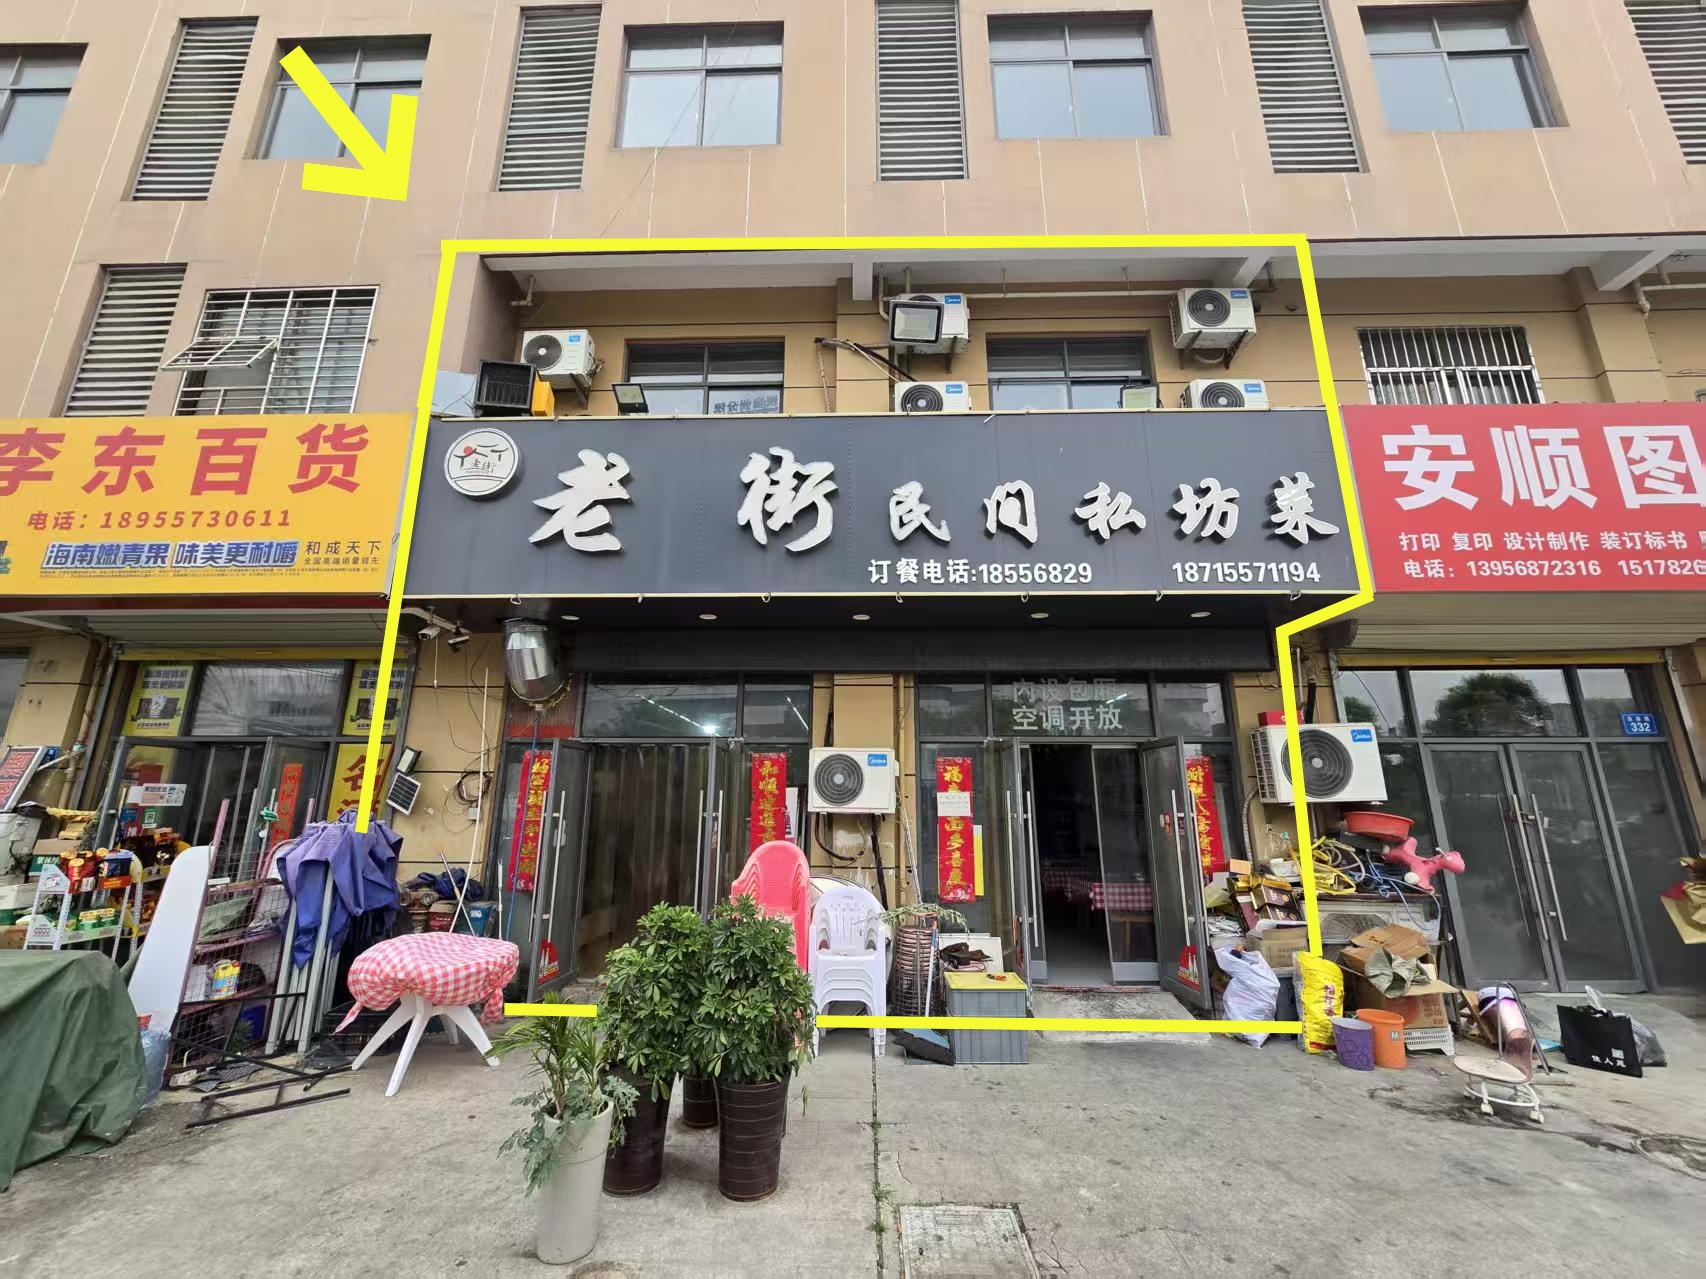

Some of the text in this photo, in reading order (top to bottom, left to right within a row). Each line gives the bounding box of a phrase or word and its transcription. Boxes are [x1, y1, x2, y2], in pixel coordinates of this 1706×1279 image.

[0, 424, 369, 497] 李东百货
[304, 540, 381, 555] 和成天下
[1398, 531, 1440, 550] 打印
[1452, 531, 1493, 550] 复印
[1503, 531, 1590, 551] 设计制作
[1599, 530, 1688, 550] 装订标书
[42, 542, 170, 567] 海南嫩青果
[174, 541, 298, 567] 味美更耐嚼
[1172, 561, 1321, 583] 18715571194
[1012, 704, 1123, 731] 空调开放
[1630, 722, 1651, 732] 332
